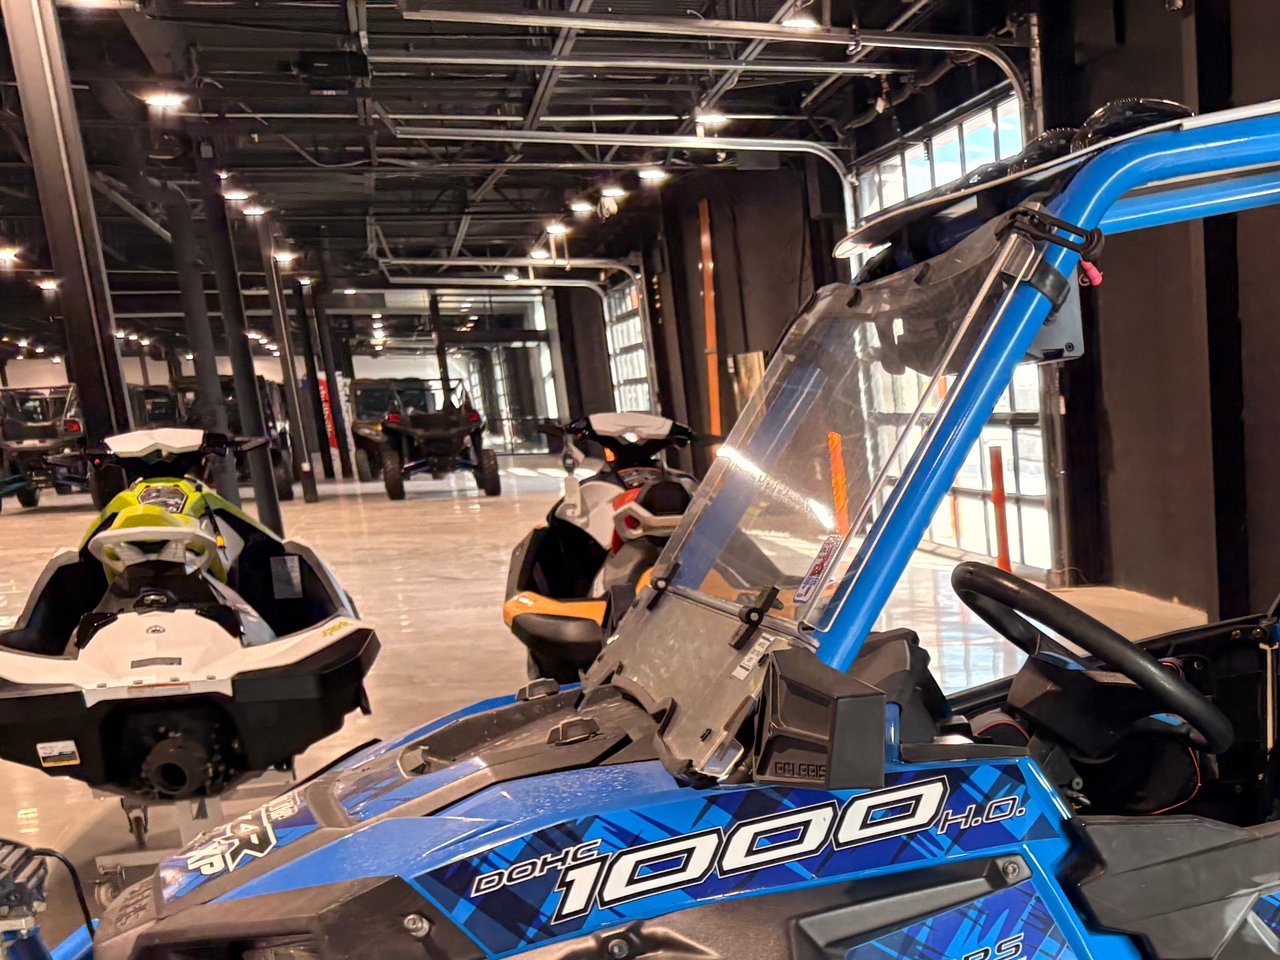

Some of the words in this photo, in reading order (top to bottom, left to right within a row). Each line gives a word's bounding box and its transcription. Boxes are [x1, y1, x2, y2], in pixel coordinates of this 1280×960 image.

[470, 838, 603, 898] DOHC
[550, 775, 949, 926] 1000
[937, 795, 1025, 836] H.O.
